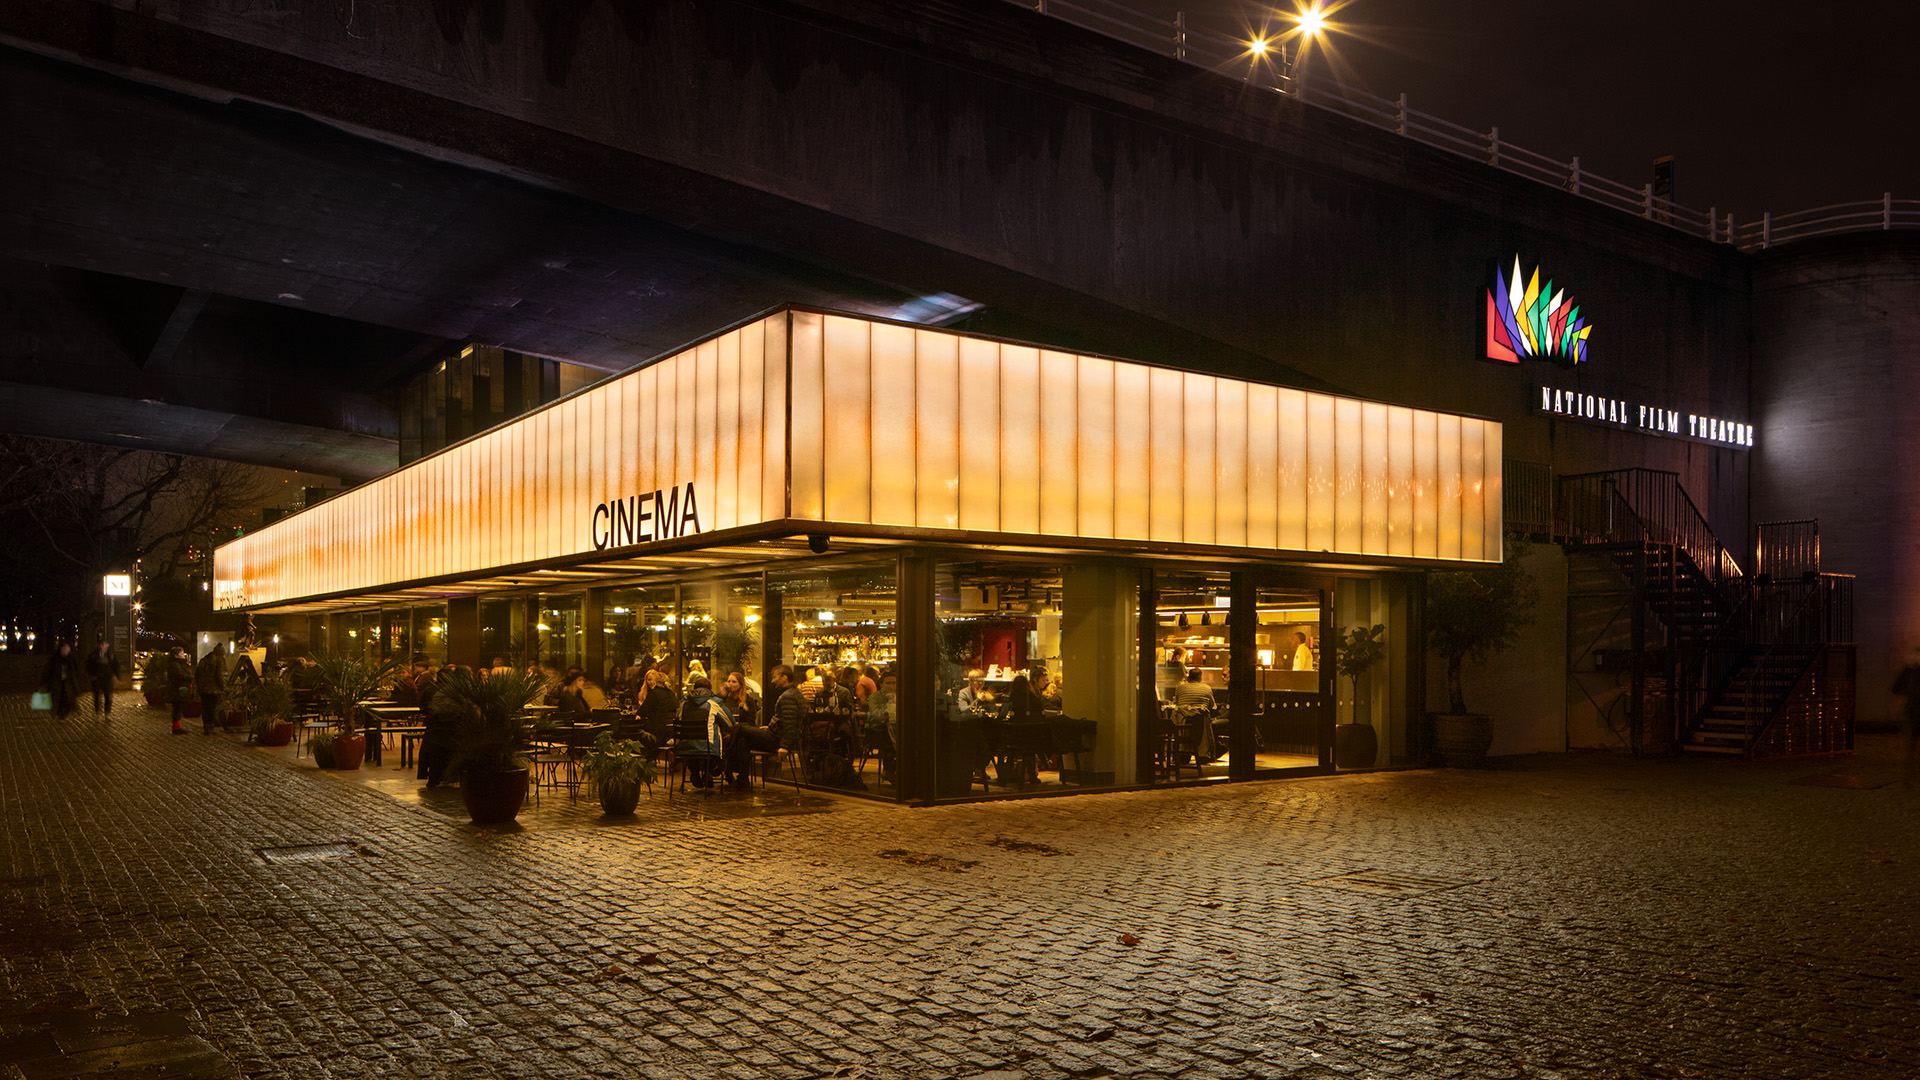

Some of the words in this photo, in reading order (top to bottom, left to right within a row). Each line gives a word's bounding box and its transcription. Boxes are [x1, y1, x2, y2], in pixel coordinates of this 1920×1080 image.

[1542, 386, 1627, 424] NATIONAL
[1640, 405, 1678, 433] FILM
[1691, 415, 1753, 446] THEATRE
[592, 482, 701, 551] CINEMA
